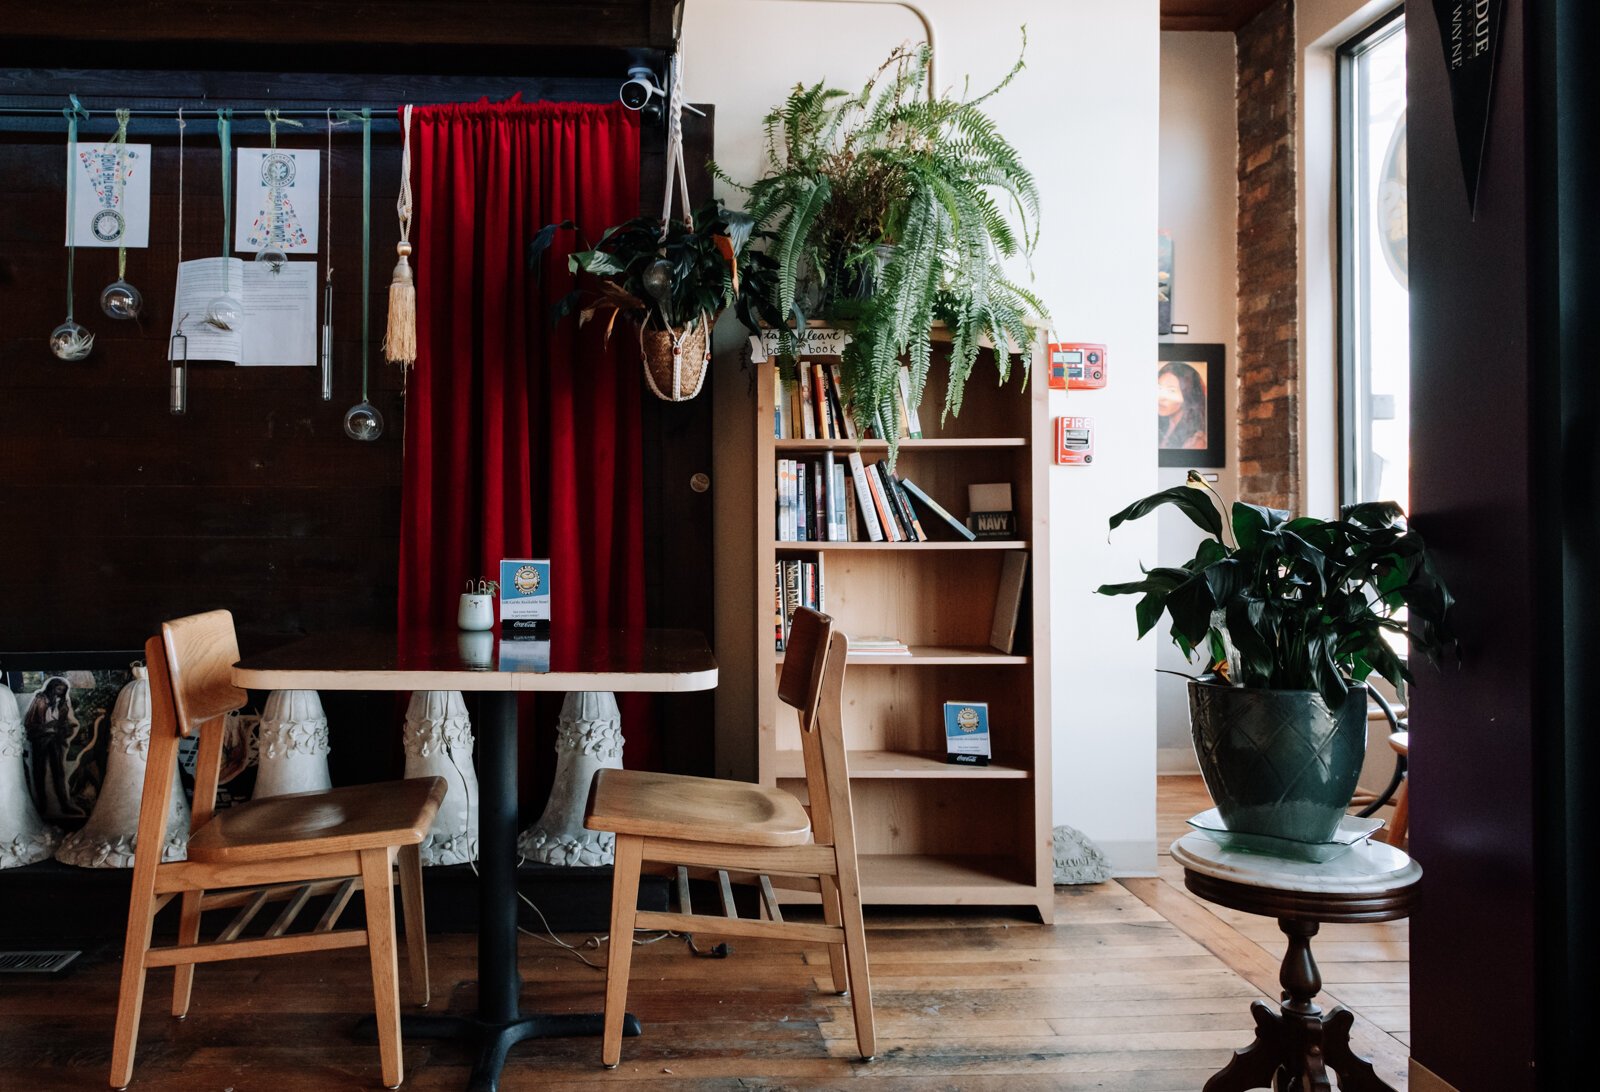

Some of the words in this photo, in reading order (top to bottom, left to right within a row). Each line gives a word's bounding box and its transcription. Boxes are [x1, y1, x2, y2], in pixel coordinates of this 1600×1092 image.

[1452, 4, 1462, 70] WAYNE
[101, 154, 116, 171] WORD
[103, 173, 115, 184] THE
[807, 329, 841, 340] leave
[808, 344, 837, 354] book
[1063, 418, 1091, 428] FIRE
[978, 517, 1008, 530] NAVY
[786, 564, 798, 588] Nelson
